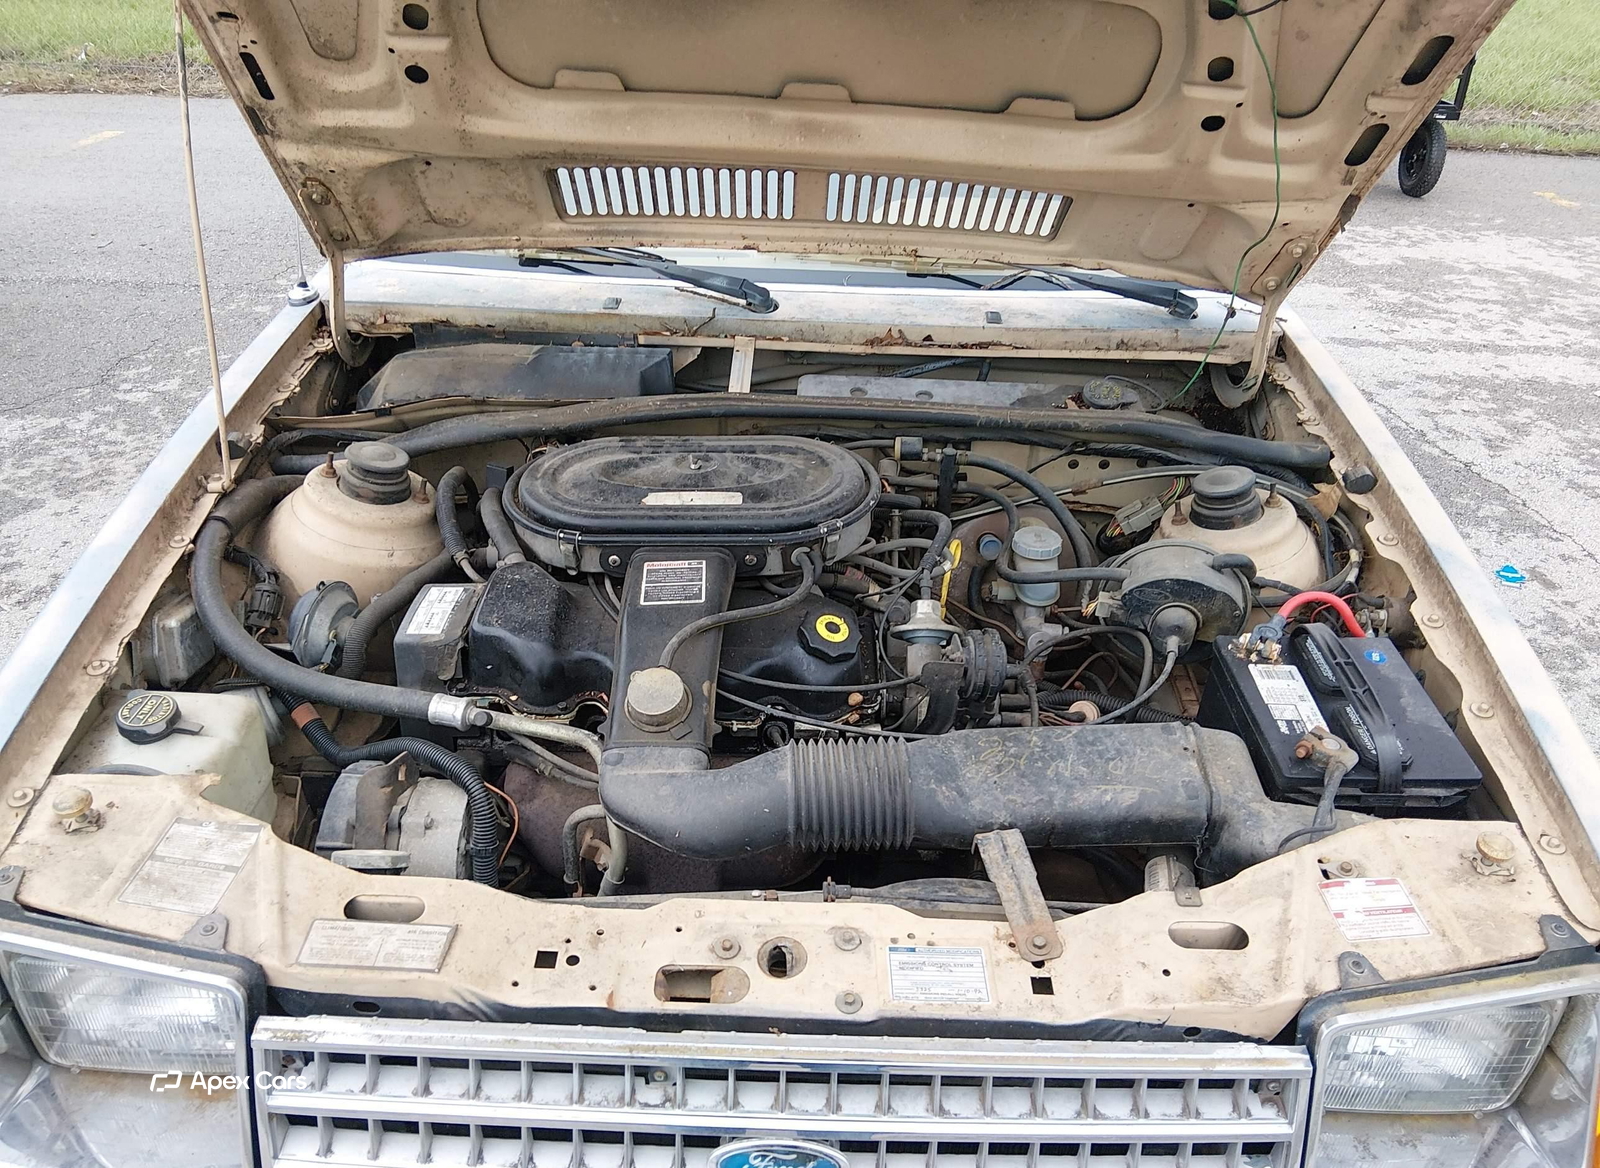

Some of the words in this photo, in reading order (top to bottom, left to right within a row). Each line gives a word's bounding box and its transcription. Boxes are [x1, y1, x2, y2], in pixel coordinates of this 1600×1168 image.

[136, 699, 157, 720] ONLY
[1345, 706, 1361, 725] POISON
[1357, 729, 1374, 750] DANGER
[198, 861, 226, 870] GARDE
